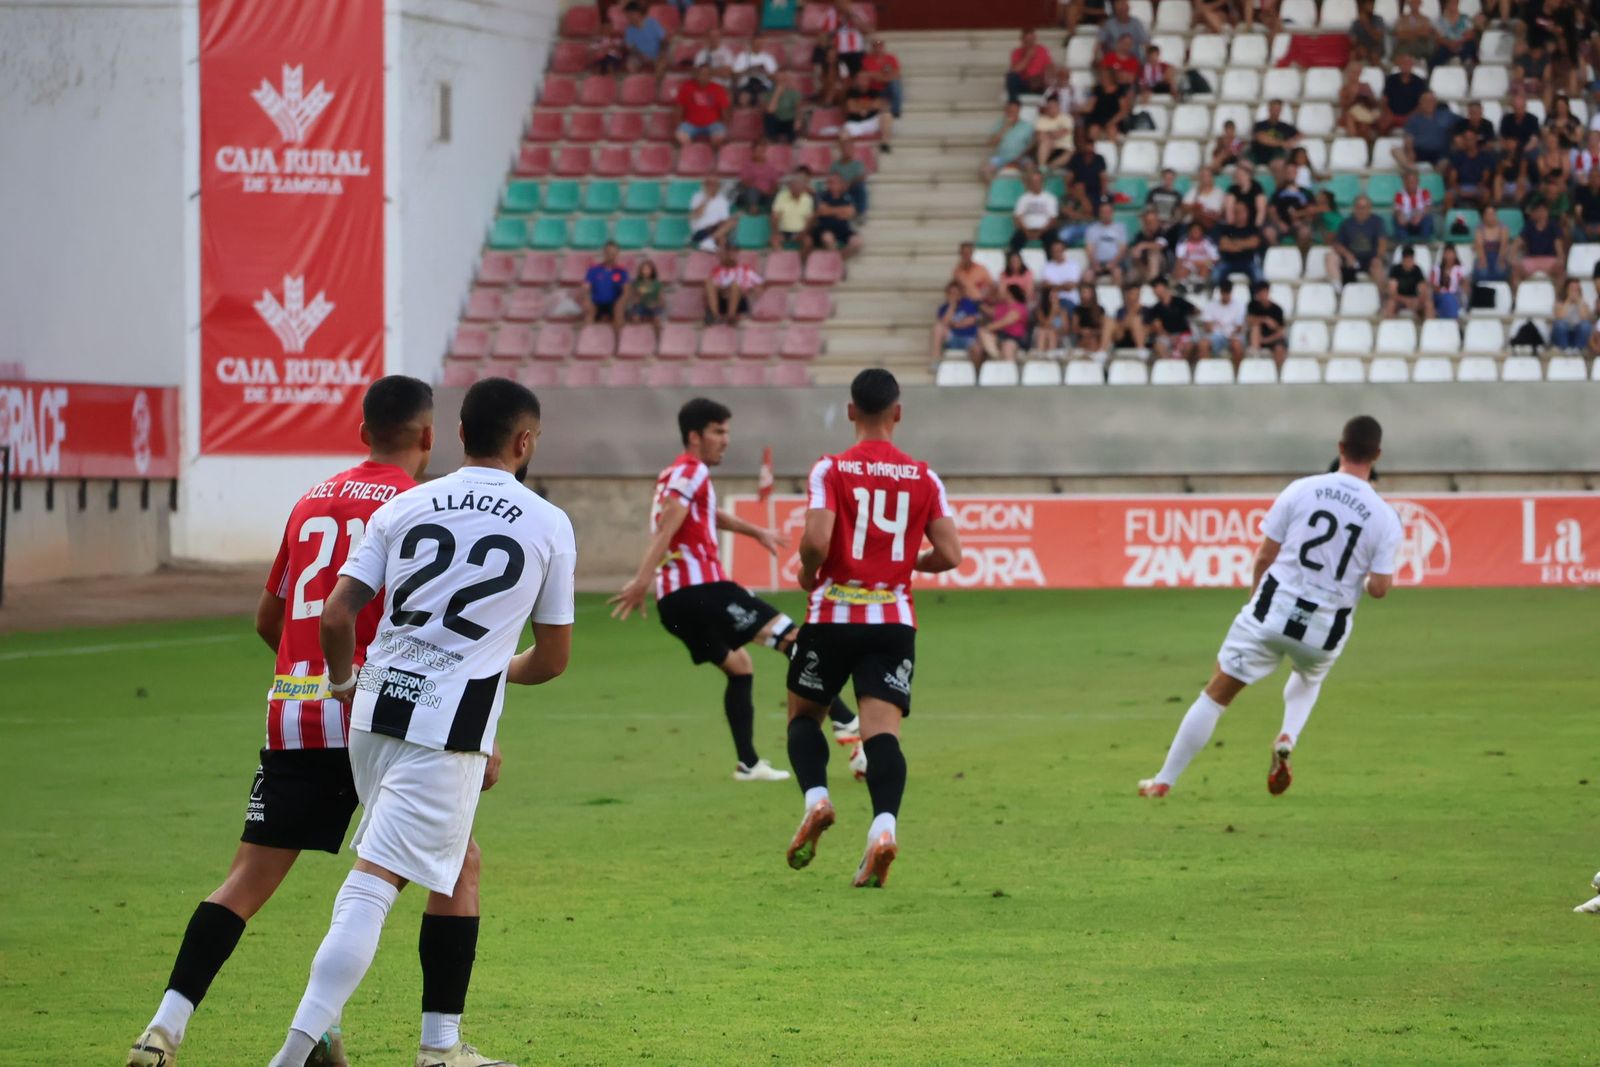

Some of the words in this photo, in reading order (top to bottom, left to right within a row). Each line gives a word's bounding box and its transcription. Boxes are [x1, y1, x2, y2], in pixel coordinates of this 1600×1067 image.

[215, 146, 279, 174] CAJA
[283, 149, 370, 176] RURAL
[243, 177, 266, 192] DE
[271, 177, 344, 195] ZAMORA
[216, 357, 279, 384] CAJA
[284, 358, 370, 385] RURAL
[244, 387, 267, 403] DE
[272, 387, 343, 405] ZAMORA
[305, 481, 337, 500] JOEL
[339, 480, 397, 503] PRIEGO
[1315, 488, 1372, 521] PRADERA
[432, 490, 524, 525] LLÁCER
[852, 487, 910, 561] 14
[1125, 508, 1266, 543] FUNDAC
[1521, 499, 1585, 564] La
[1299, 509, 1363, 581] 21
[389, 523, 526, 642] 22
[911, 547, 1047, 587] ORA
[1540, 564, 1564, 584] El
[366, 680, 384, 695] DE
[372, 665, 436, 693] GOBIERNO
